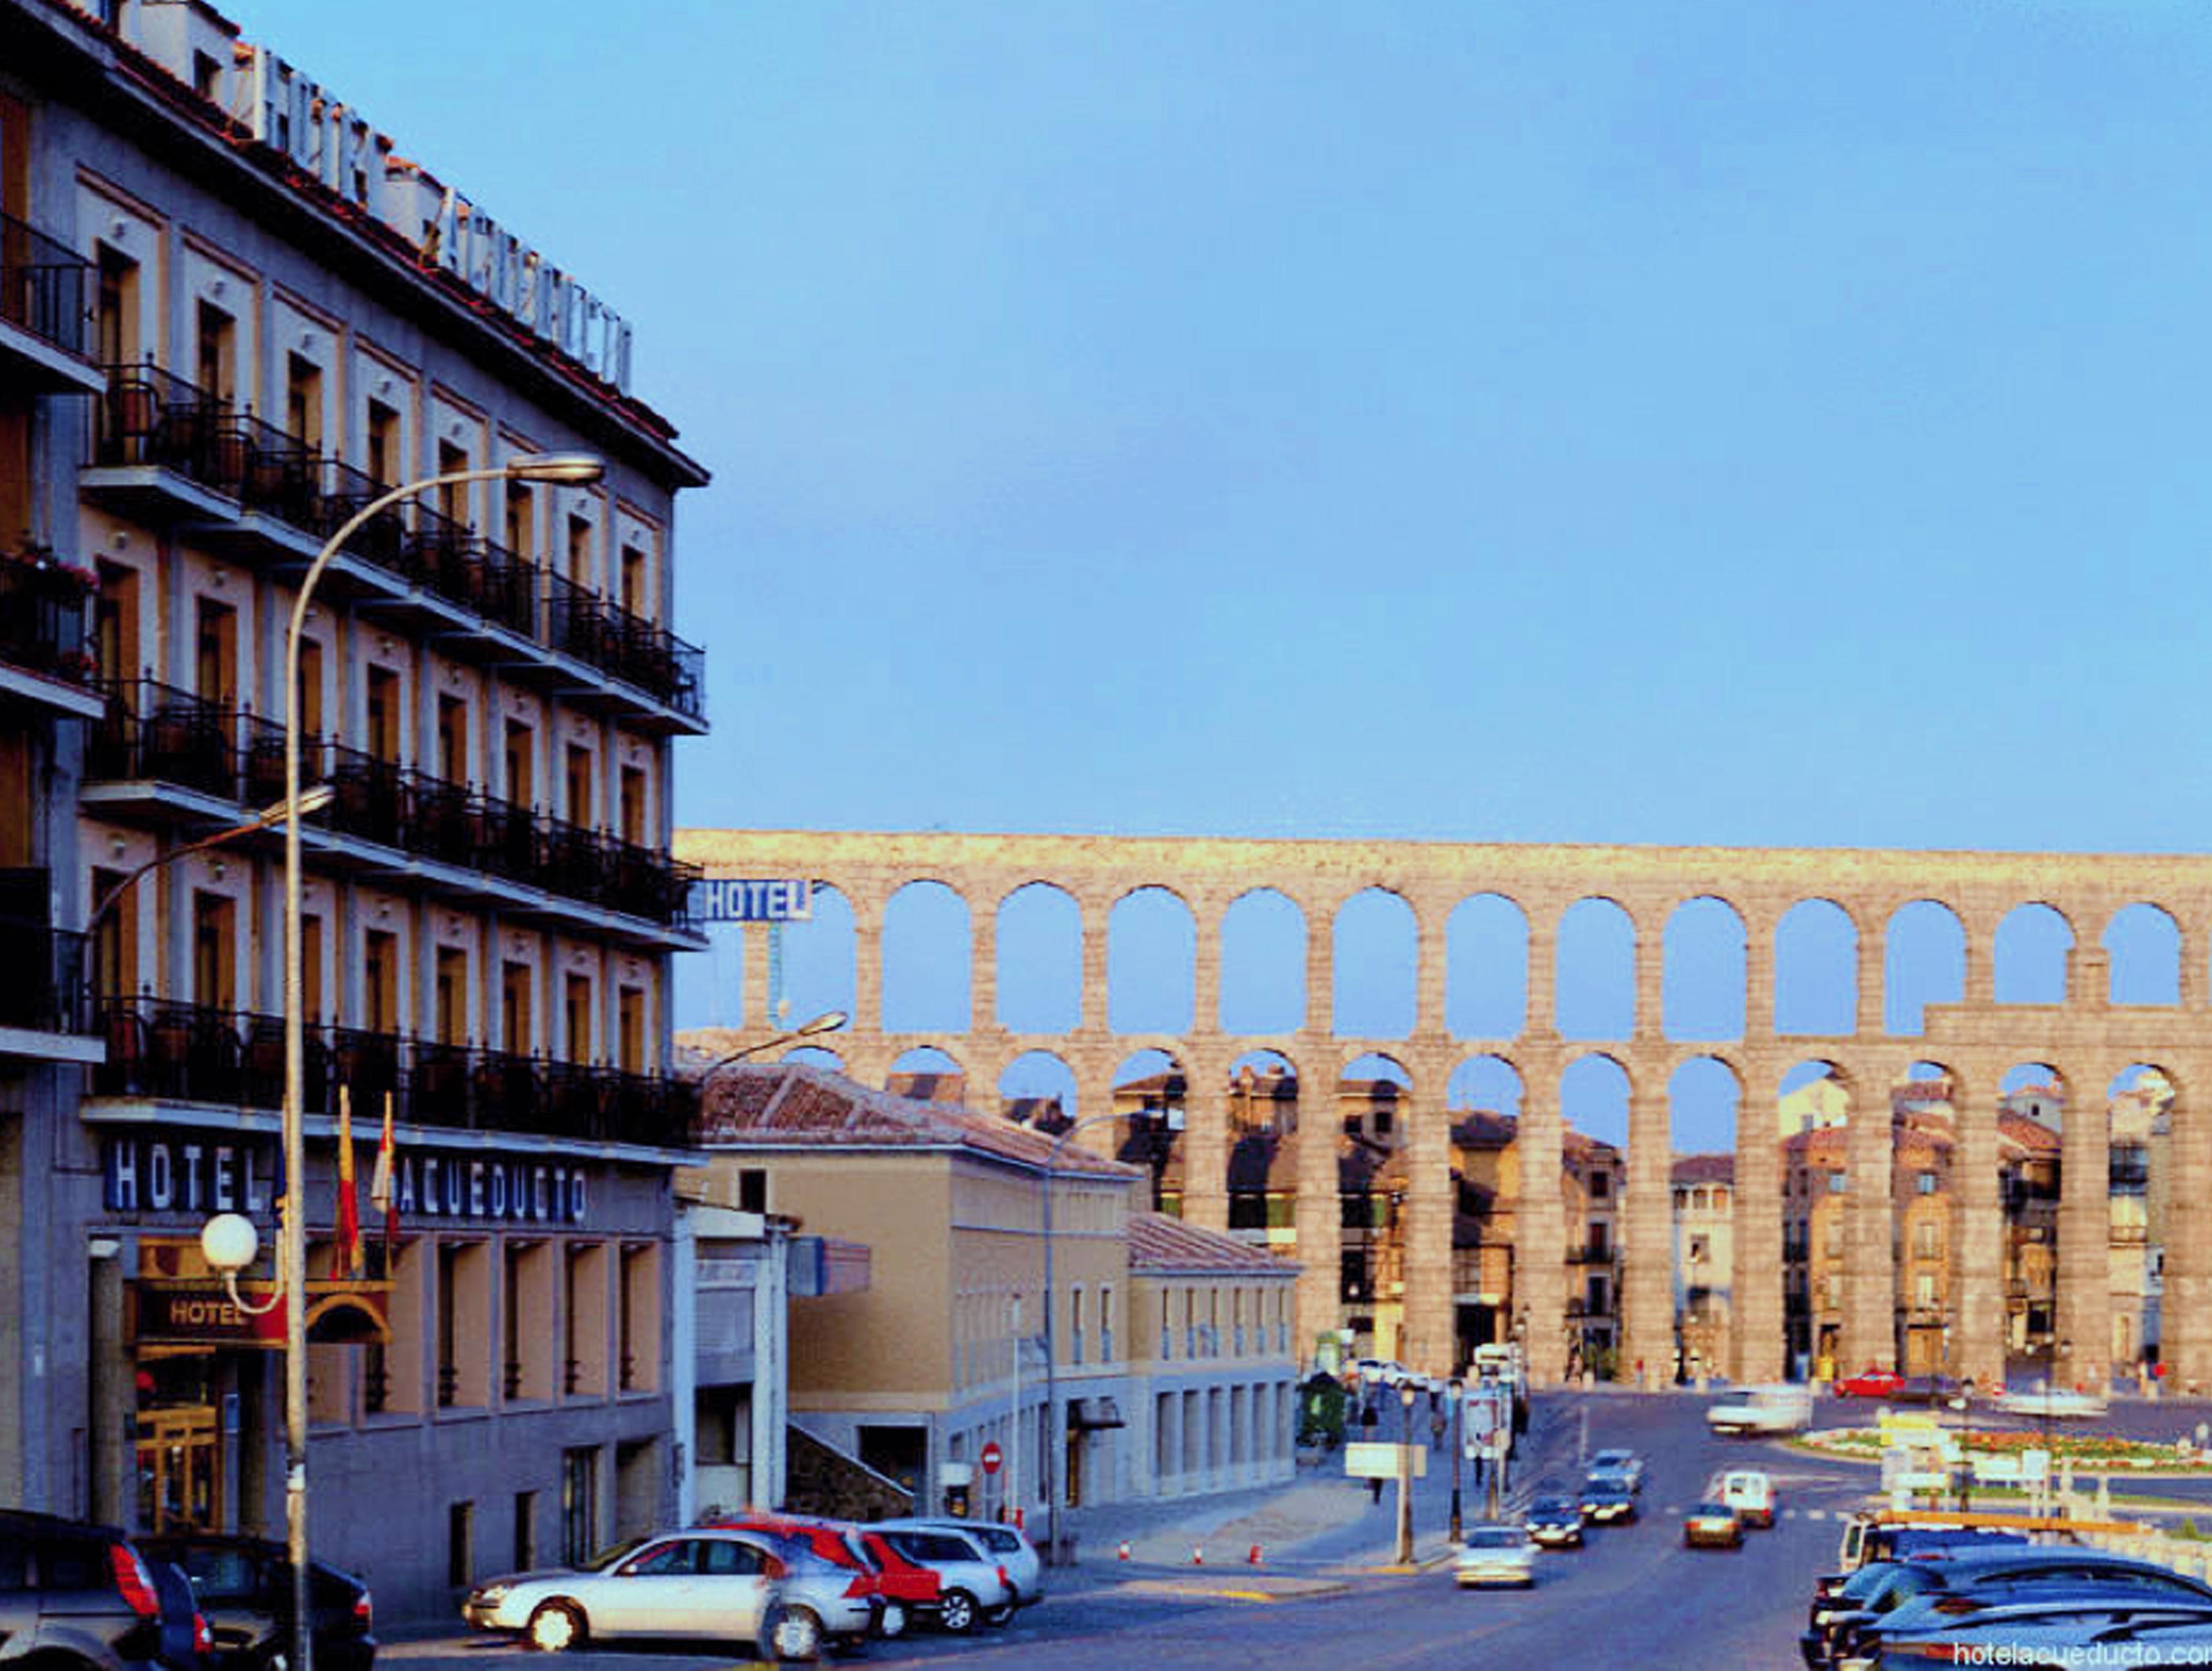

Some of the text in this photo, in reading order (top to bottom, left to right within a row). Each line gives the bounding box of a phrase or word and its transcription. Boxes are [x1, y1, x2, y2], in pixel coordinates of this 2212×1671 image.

[704, 882, 814, 919] HOTEL
[115, 1139, 587, 1222] HOTEL ACUEDUCTO
[170, 1299, 250, 1326] HOTEL
